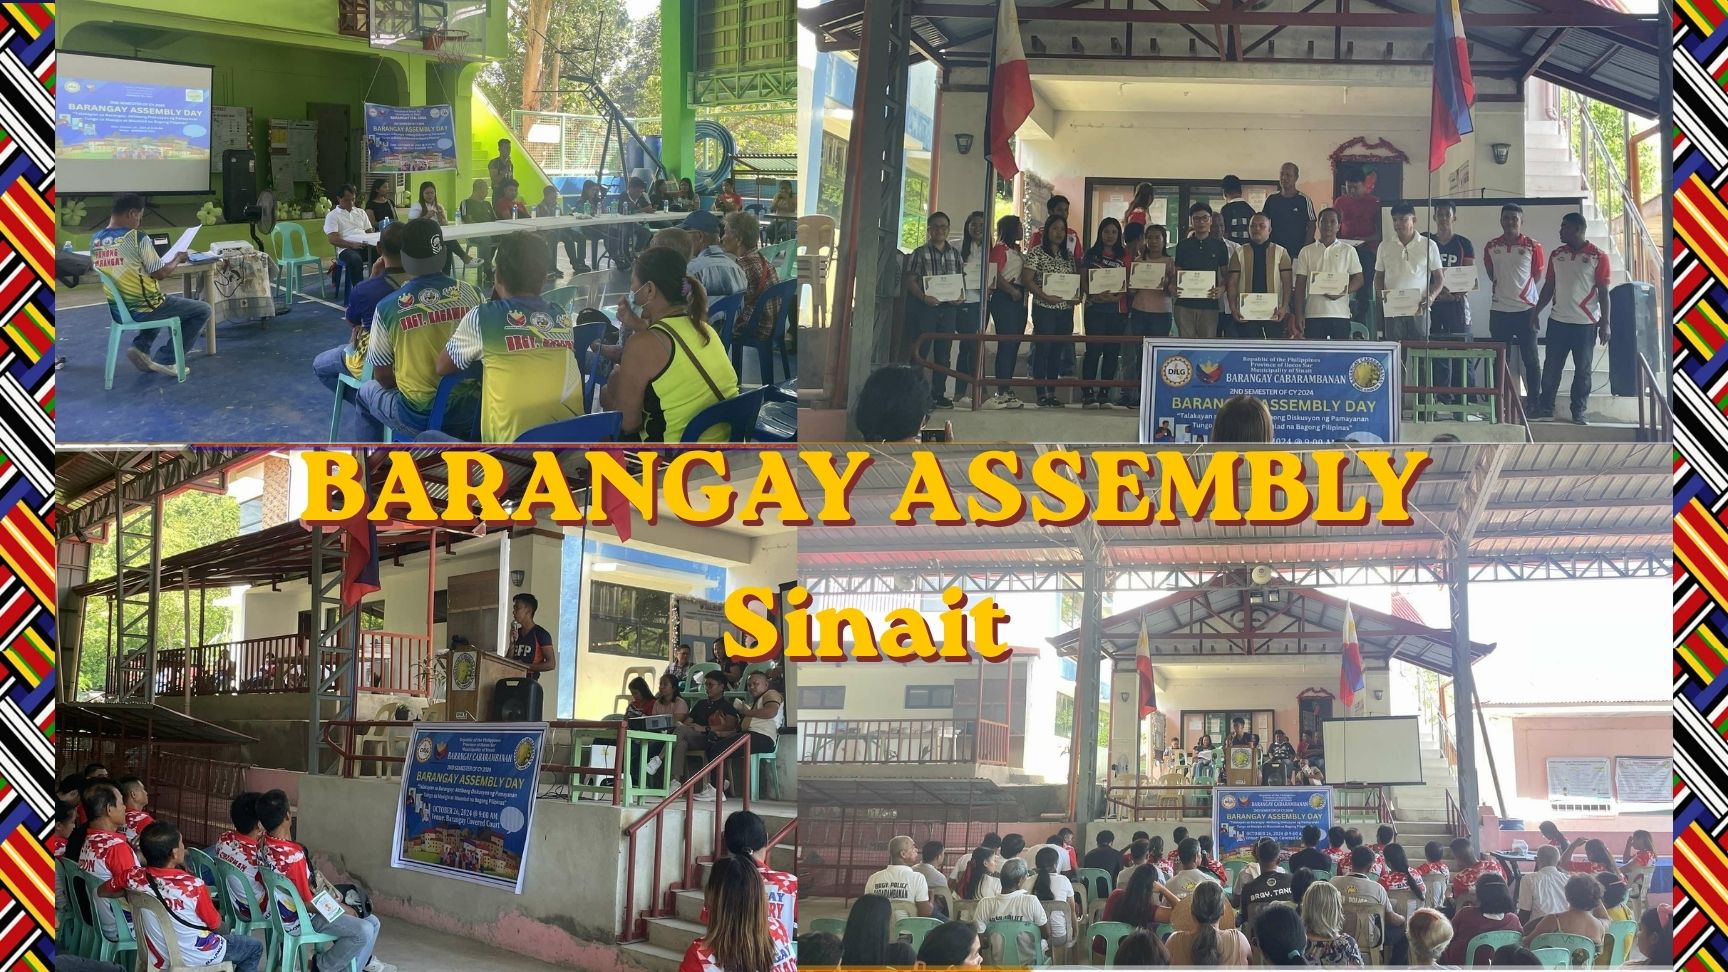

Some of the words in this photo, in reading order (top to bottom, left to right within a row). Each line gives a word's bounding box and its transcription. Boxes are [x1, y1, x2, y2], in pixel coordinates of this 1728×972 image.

[68, 103, 128, 112] BARANGAY
[130, 106, 182, 116] ASSEMBLY
[1226, 373, 1272, 383] BARANGAY
[1274, 374, 1346, 384] CABARAMBANAN
[1346, 400, 1376, 412] DAY
[448, 752, 472, 760] BARANGAY
[416, 771, 459, 784] BARANGAY
[460, 774, 504, 788] ASSEMBLY
[506, 778, 526, 790] DAY
[432, 806, 452, 814] OCTOBER
[446, 815, 466, 826] Barangay
[466, 818, 486, 826] Covered
